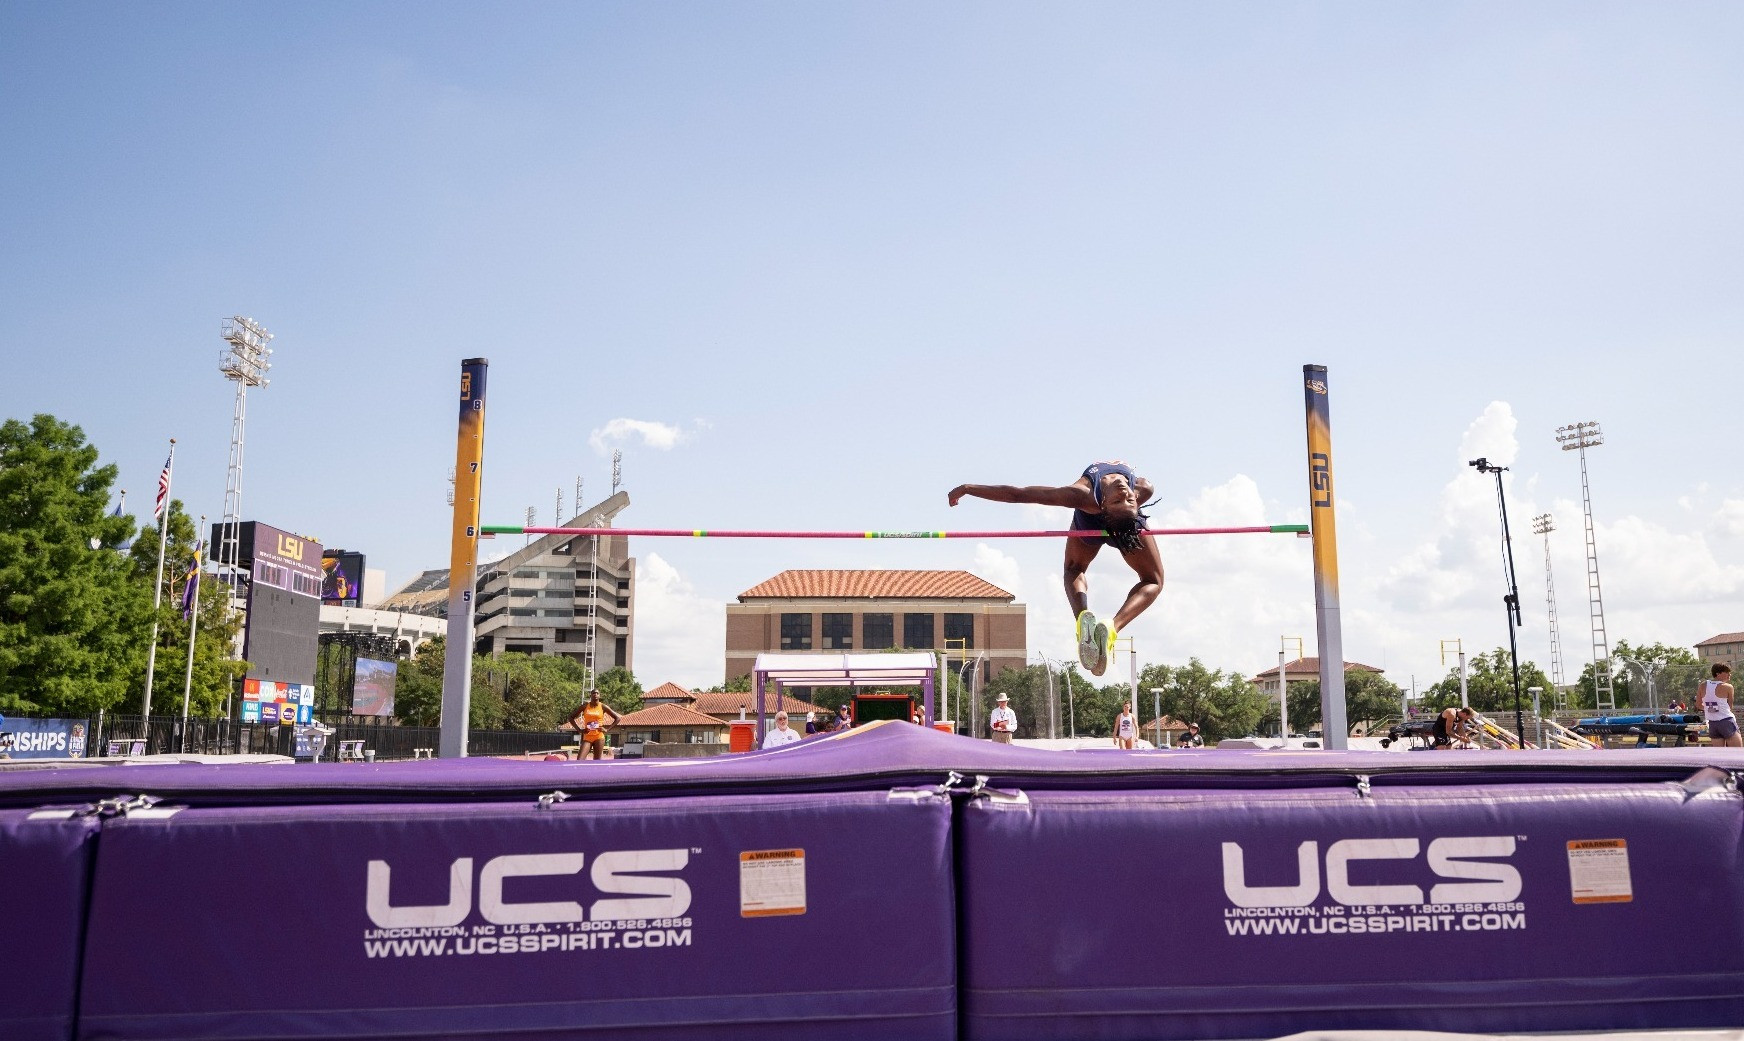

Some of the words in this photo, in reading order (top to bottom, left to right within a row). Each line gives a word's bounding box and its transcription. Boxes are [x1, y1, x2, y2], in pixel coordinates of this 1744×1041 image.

[461, 372, 471, 400] LSU
[474, 399, 482, 410] 8
[470, 462, 478, 473] 7
[1312, 453, 1331, 507] LSU
[467, 526, 475, 536] 6
[277, 533, 303, 560] LSU
[463, 591, 471, 602] 5
[0, 732, 66, 751] NSHIPS
[755, 851, 796, 859] WARNING
[1222, 836, 1523, 908] UCS
[366, 848, 692, 929] UCS
[1224, 907, 1320, 918] LINCOLNTON,
[1324, 906, 1345, 915] NC
[1351, 905, 1395, 915] U.S.A.
[1409, 902, 1525, 914] 1.800.526.4856
[364, 926, 469, 939] LINCOLNTON,
[473, 925, 496, 935] NC
[503, 924, 551, 934] U.S.A.
[567, 917, 693, 932] 1.800.526.4856
[1224, 913, 1526, 936] WWW.UCSSPIRIT.COM
[364, 929, 692, 958] WWW.UCSSPIRIT.COM
